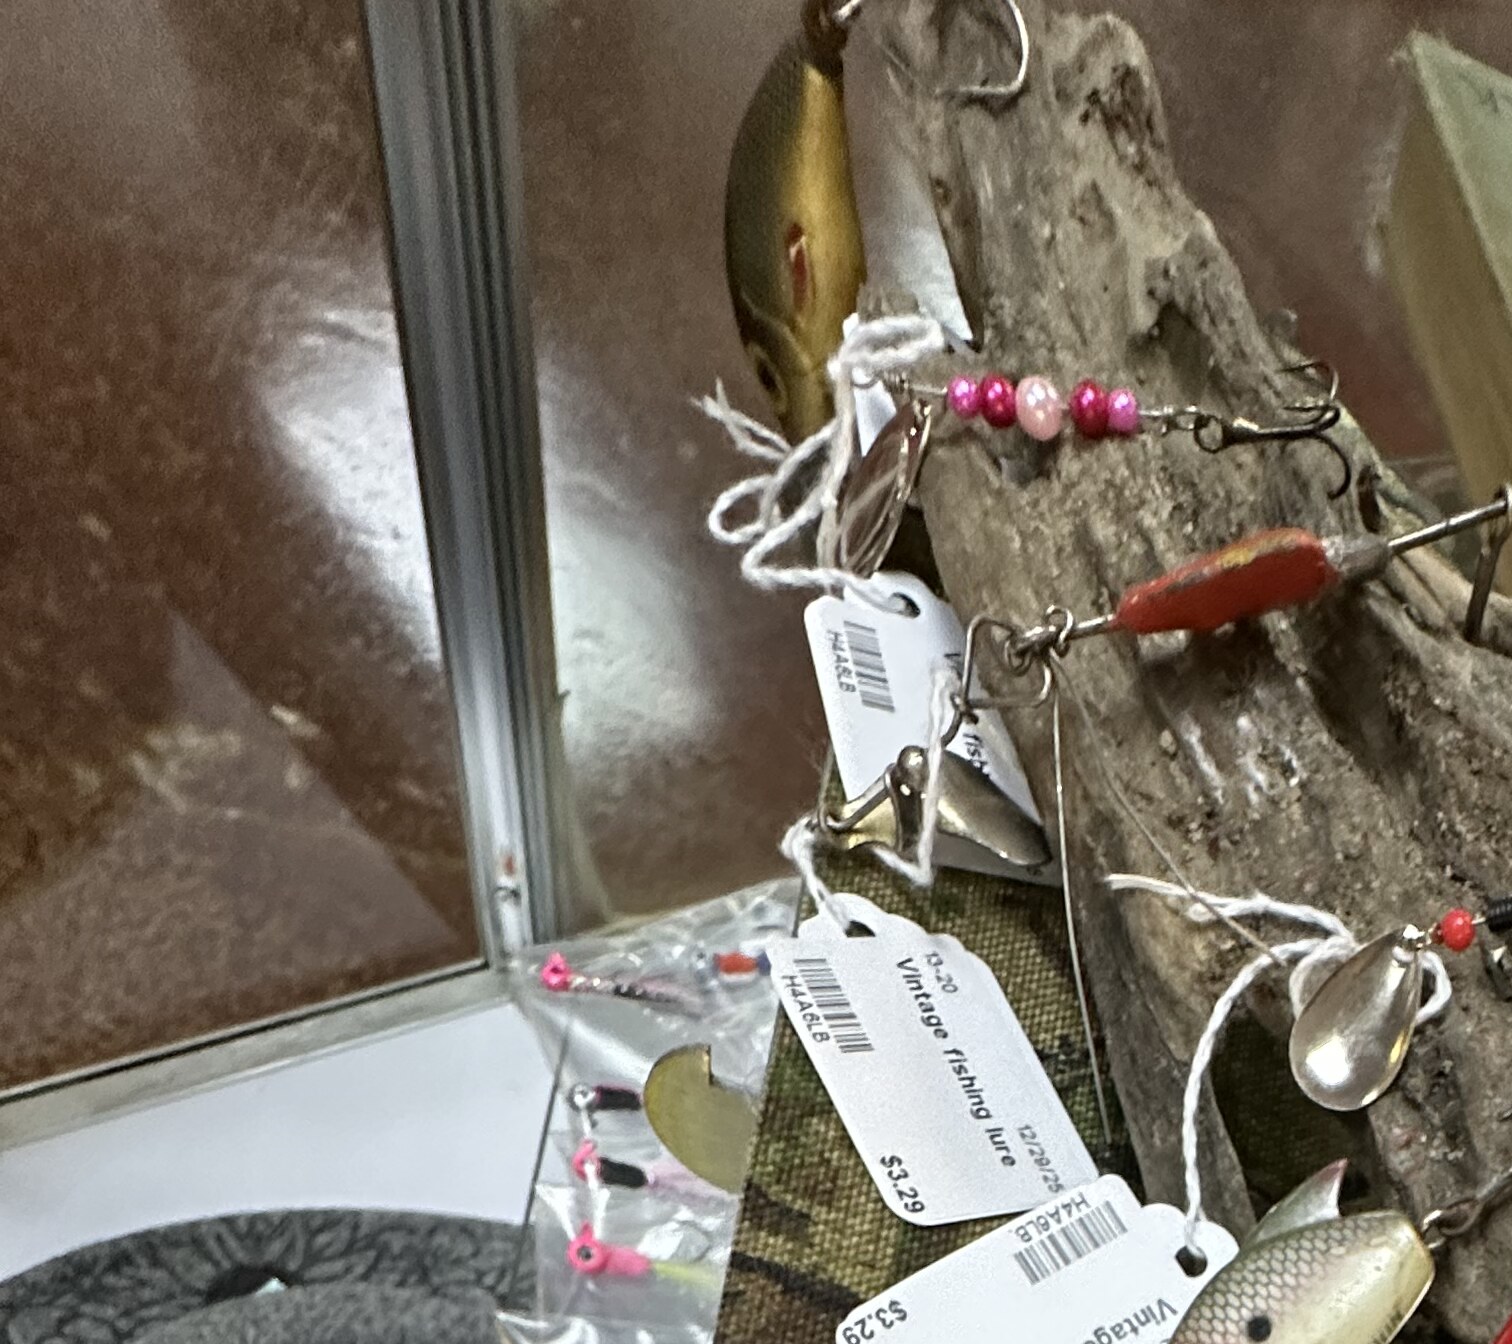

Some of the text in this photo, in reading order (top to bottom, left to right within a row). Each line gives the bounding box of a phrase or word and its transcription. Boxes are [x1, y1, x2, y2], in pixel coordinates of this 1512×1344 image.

[925, 950, 959, 995] 13-20
[782, 974, 831, 1043] H4A6LB
[896, 956, 1016, 1168] Vintage fishing lure
[880, 1154, 926, 1215] $3.29
[1013, 1191, 1091, 1244] H4A6LB
